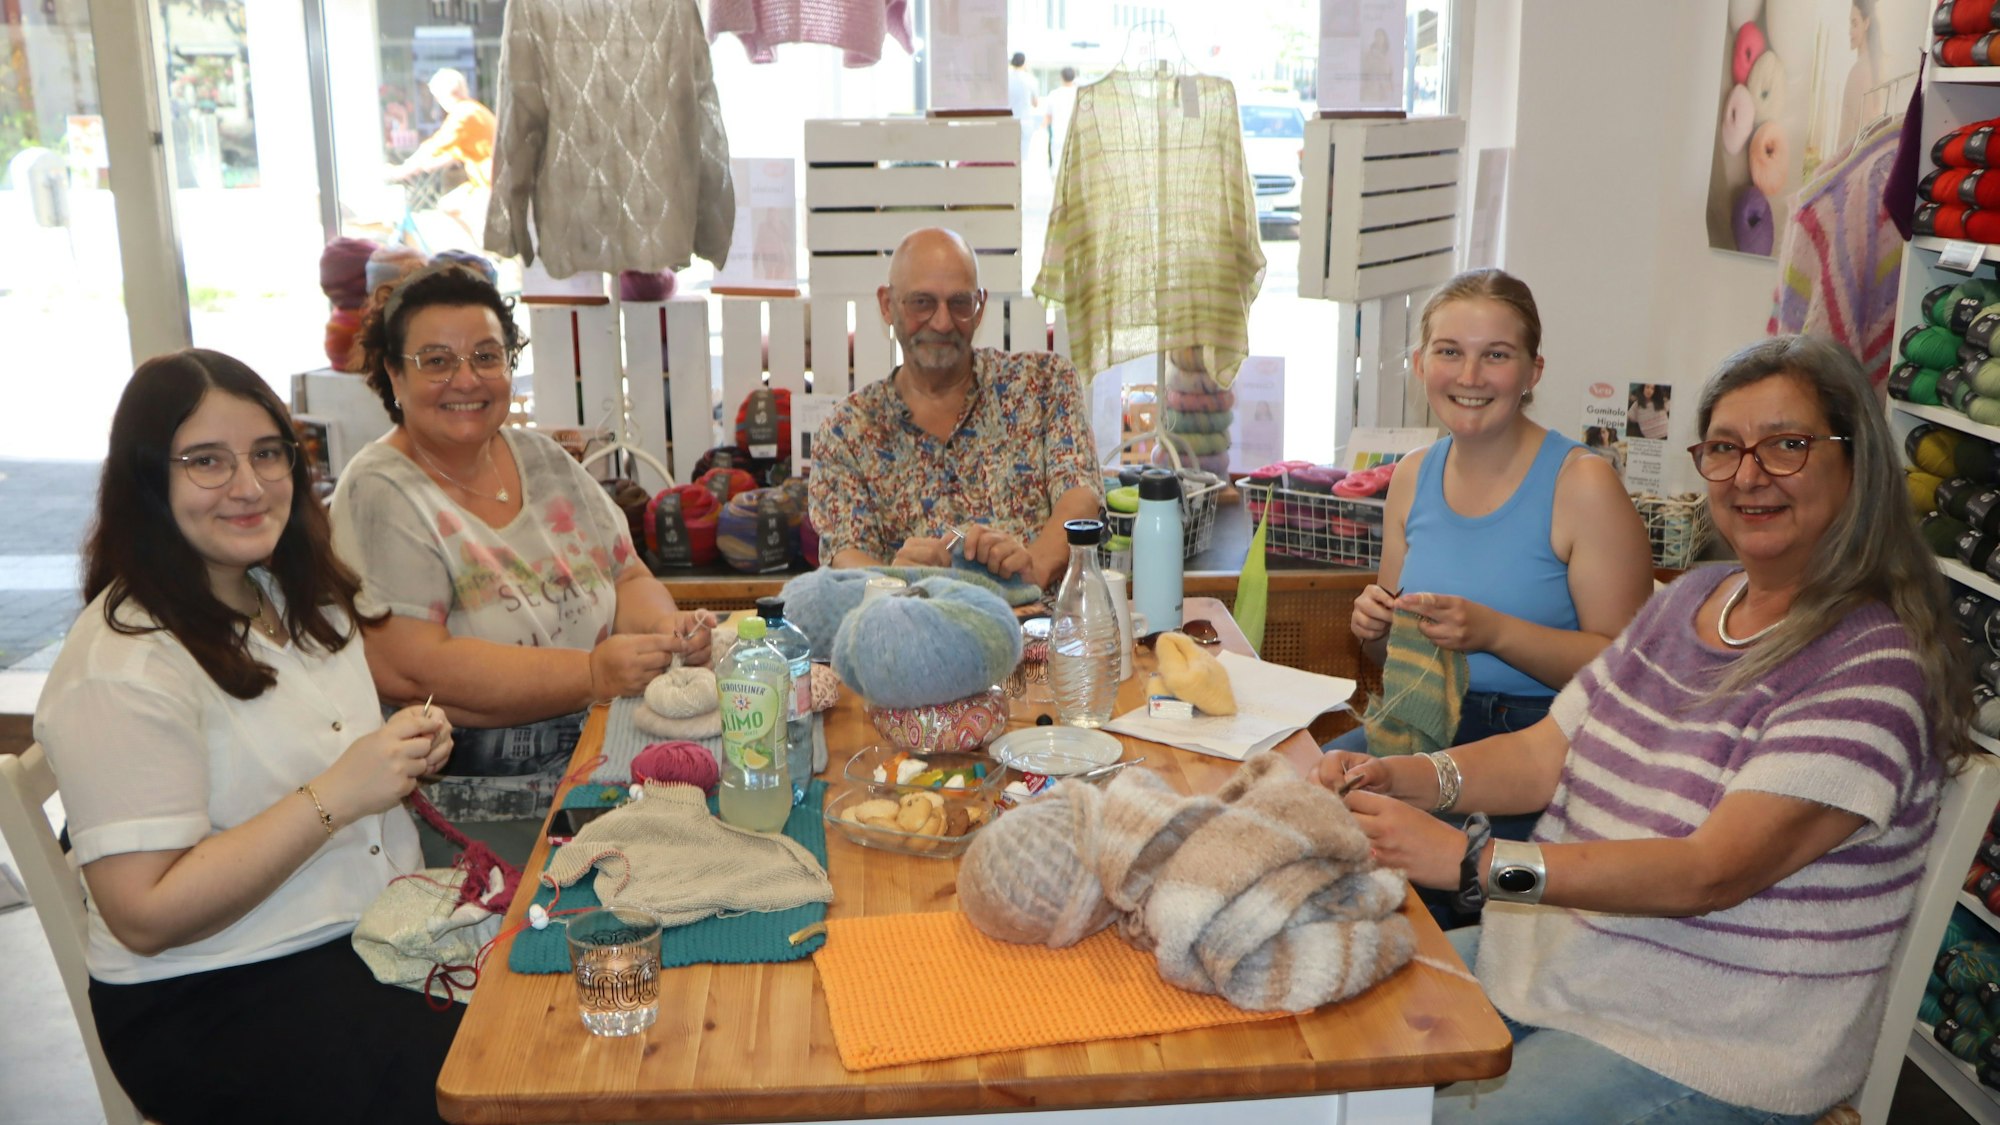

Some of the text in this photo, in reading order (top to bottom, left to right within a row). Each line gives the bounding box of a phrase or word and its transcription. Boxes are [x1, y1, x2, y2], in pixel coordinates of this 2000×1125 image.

[1586, 405, 1626, 417] Gomitolo
[1597, 418, 1625, 429] Hippie
[725, 711, 764, 731] LIMO
